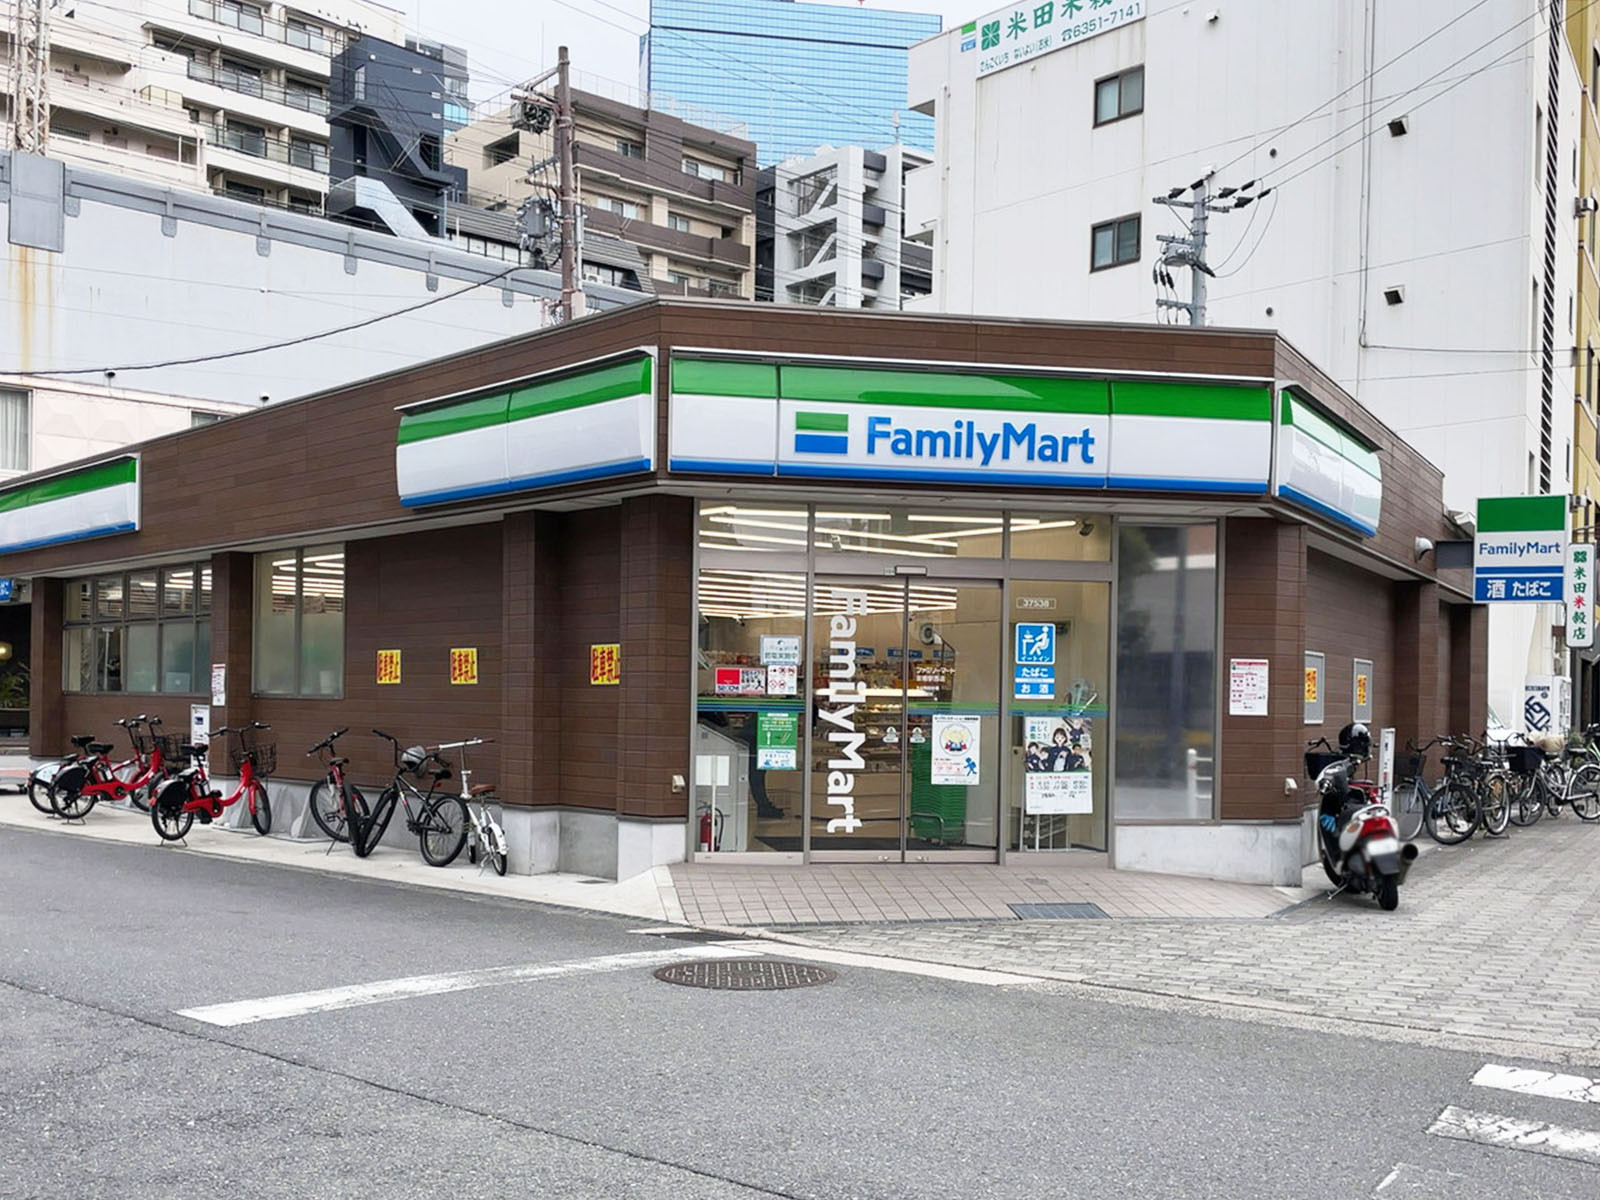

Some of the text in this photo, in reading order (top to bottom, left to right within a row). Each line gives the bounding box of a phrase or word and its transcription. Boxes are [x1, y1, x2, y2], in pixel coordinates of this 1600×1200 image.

[867, 416, 1096, 467] FamilyMart
[1479, 541, 1561, 558] FamilyMart
[1487, 579, 1552, 599] 酒 たばこ
[1571, 566, 1588, 641] 米田米穀店
[1021, 655, 1050, 663] イートイン
[1021, 667, 1049, 678] たばこ
[818, 590, 868, 834] FamilyMart
